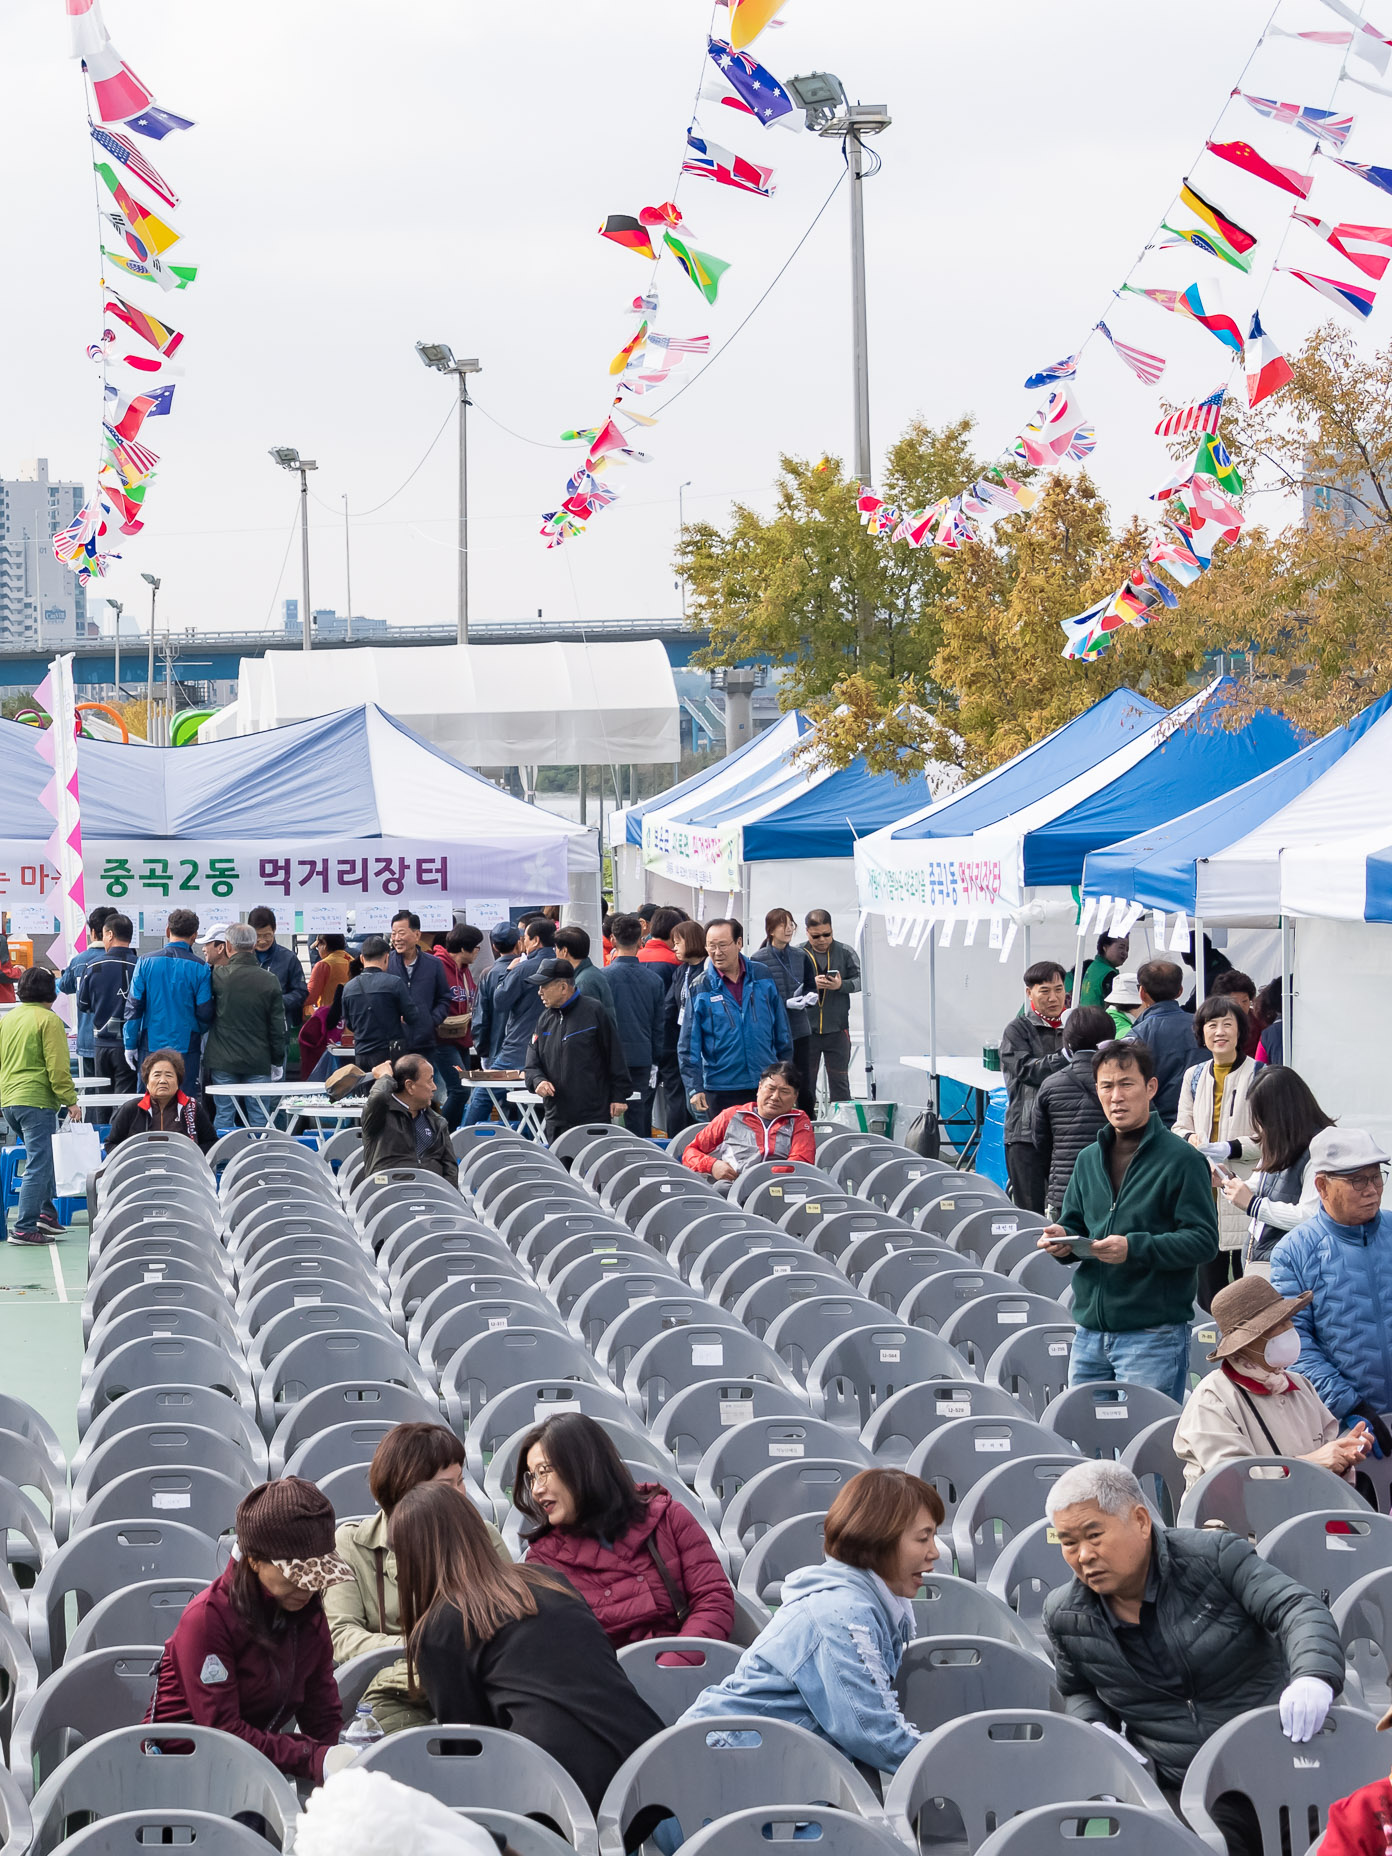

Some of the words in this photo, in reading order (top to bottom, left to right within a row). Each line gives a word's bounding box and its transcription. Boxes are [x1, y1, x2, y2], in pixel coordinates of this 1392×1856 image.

[20, 864, 62, 895] 마
[100, 858, 240, 898] 중곡2동
[259, 856, 448, 896] 먹거리장터
[929, 861, 958, 906] 중곡1동
[959, 860, 1002, 905] 먹거리장터
